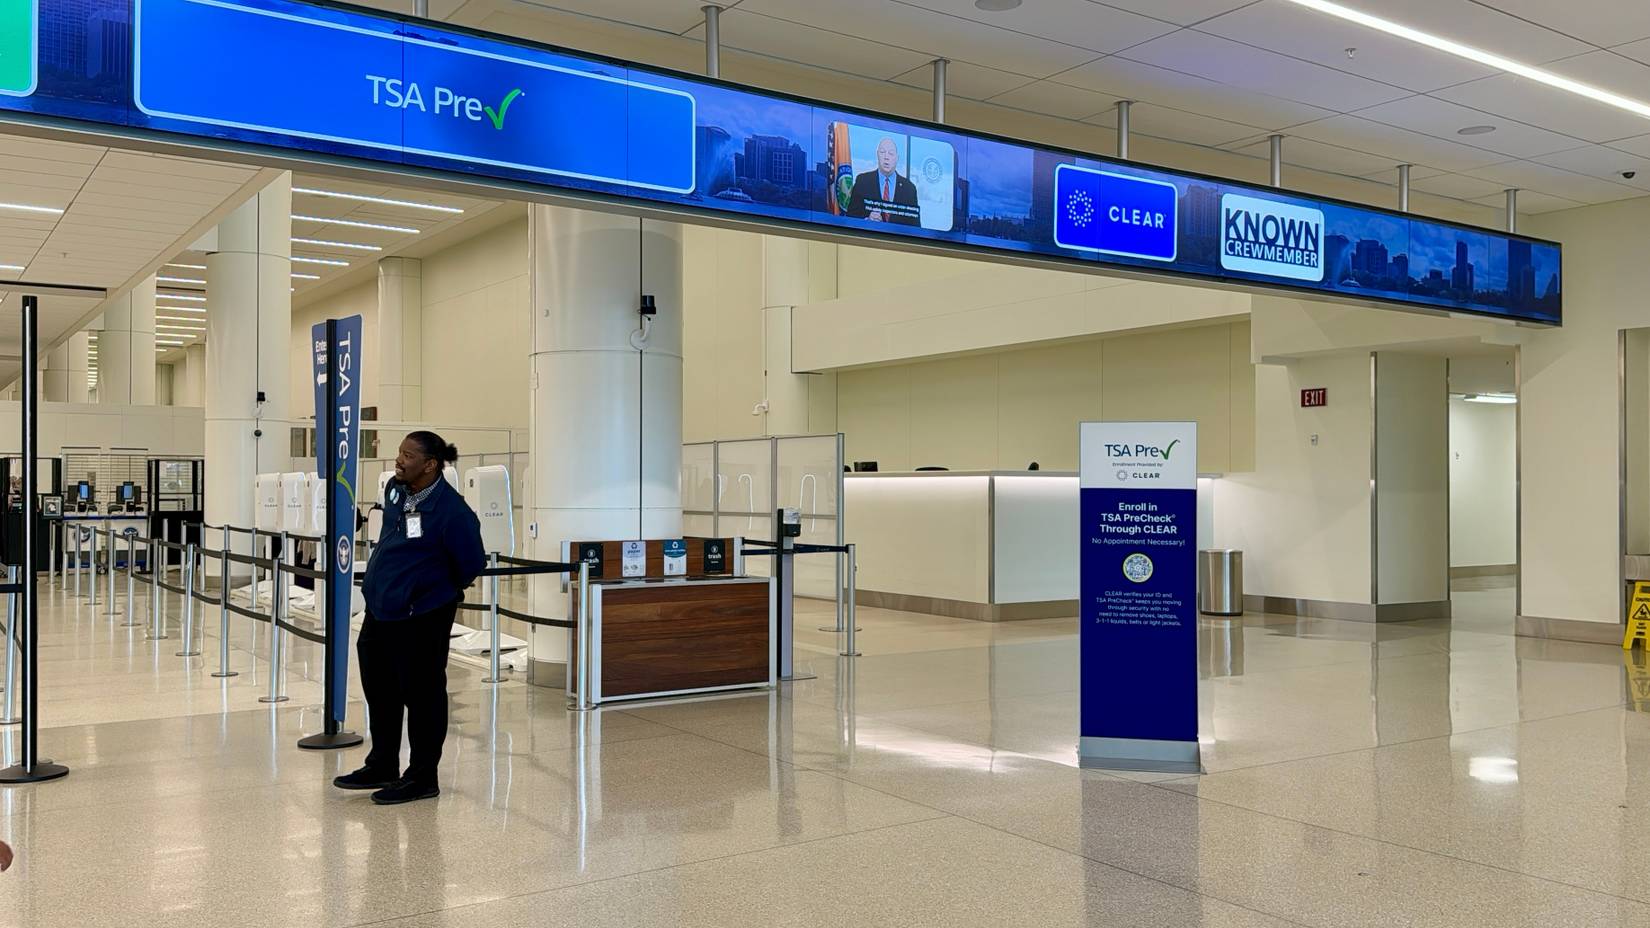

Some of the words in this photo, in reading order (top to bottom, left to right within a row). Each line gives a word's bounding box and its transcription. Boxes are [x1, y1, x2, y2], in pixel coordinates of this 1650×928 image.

[365, 74, 426, 112] TSA
[1109, 206, 1164, 229] CLEAR
[1225, 207, 1319, 251] KNOWN
[1225, 239, 1318, 267] CREWMEMBER
[315, 340, 327, 352] Ente
[338, 331, 351, 396] TSA
[1305, 390, 1324, 405] EXIT
[1104, 444, 1132, 457] TSA
[1118, 502, 1147, 511] Enroll
[1148, 502, 1158, 511] in
[1101, 513, 1122, 522] TSA
[1100, 524, 1141, 535] Through
[1143, 525, 1177, 534] CLEAR
[1103, 537, 1145, 545] Appointment
[1147, 538, 1186, 547] Necessary!
